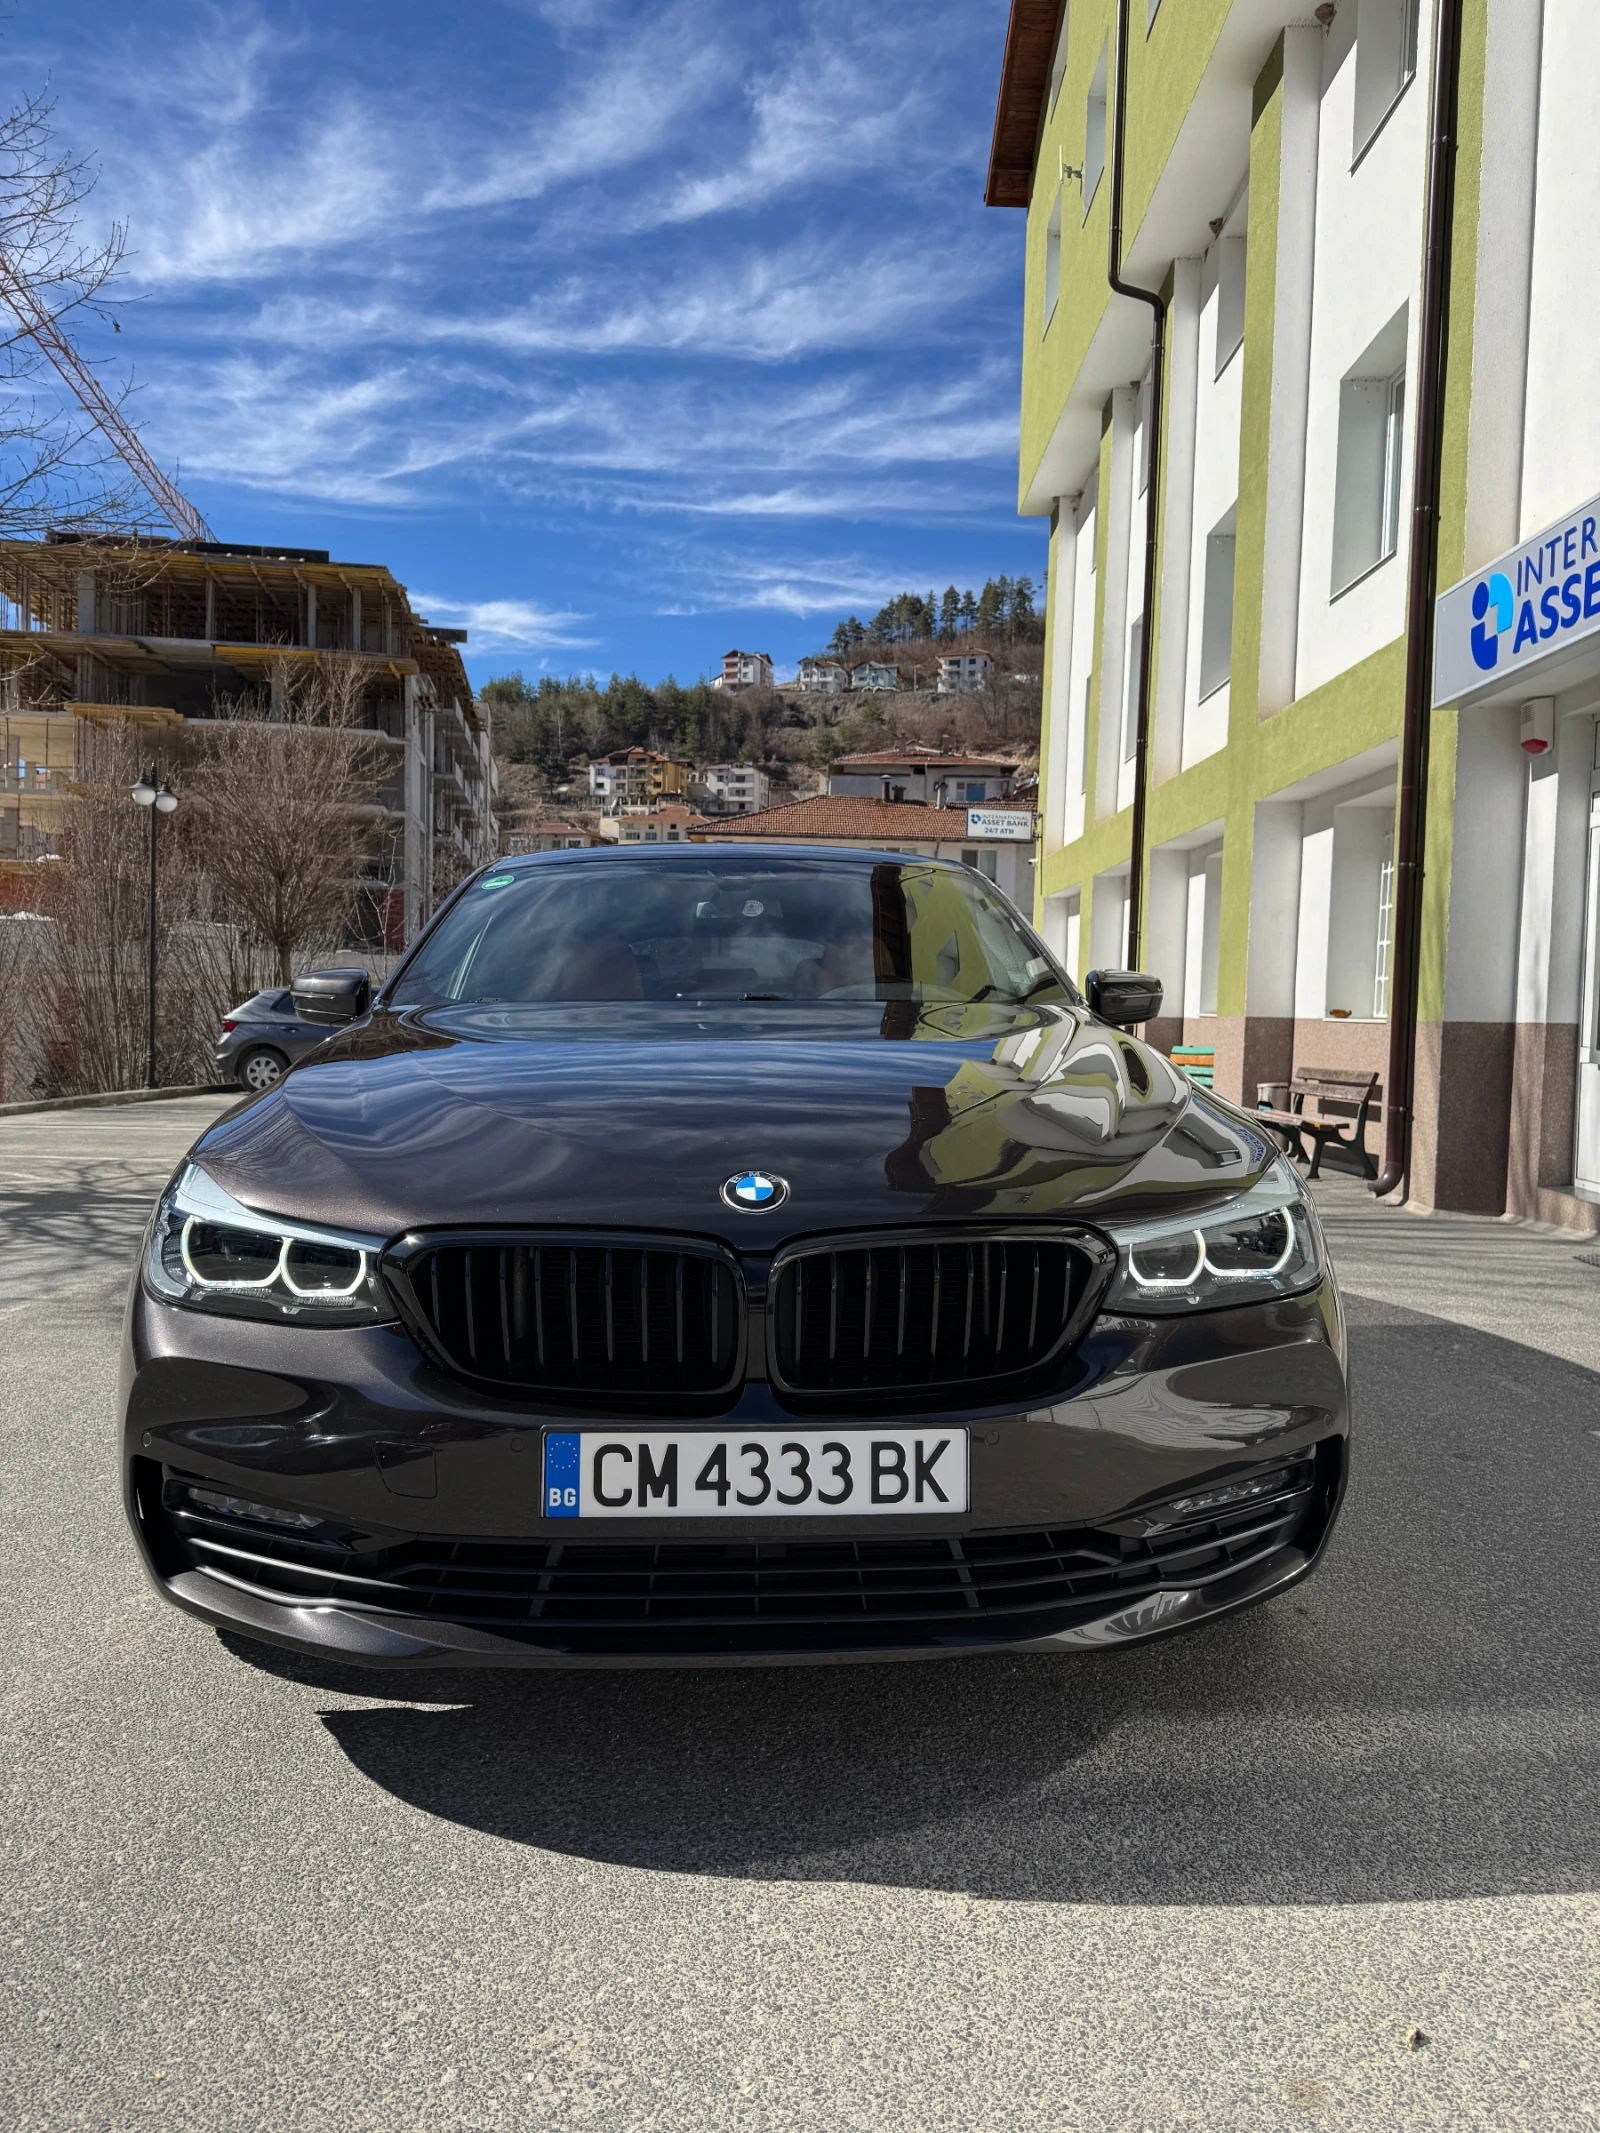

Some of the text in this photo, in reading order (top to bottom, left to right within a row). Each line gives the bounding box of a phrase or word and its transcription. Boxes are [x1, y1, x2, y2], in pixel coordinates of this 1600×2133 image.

[1517, 516, 1598, 597] INTER
[548, 1487, 577, 1508] BG
[593, 1440, 952, 1508] CM 4333 BK
